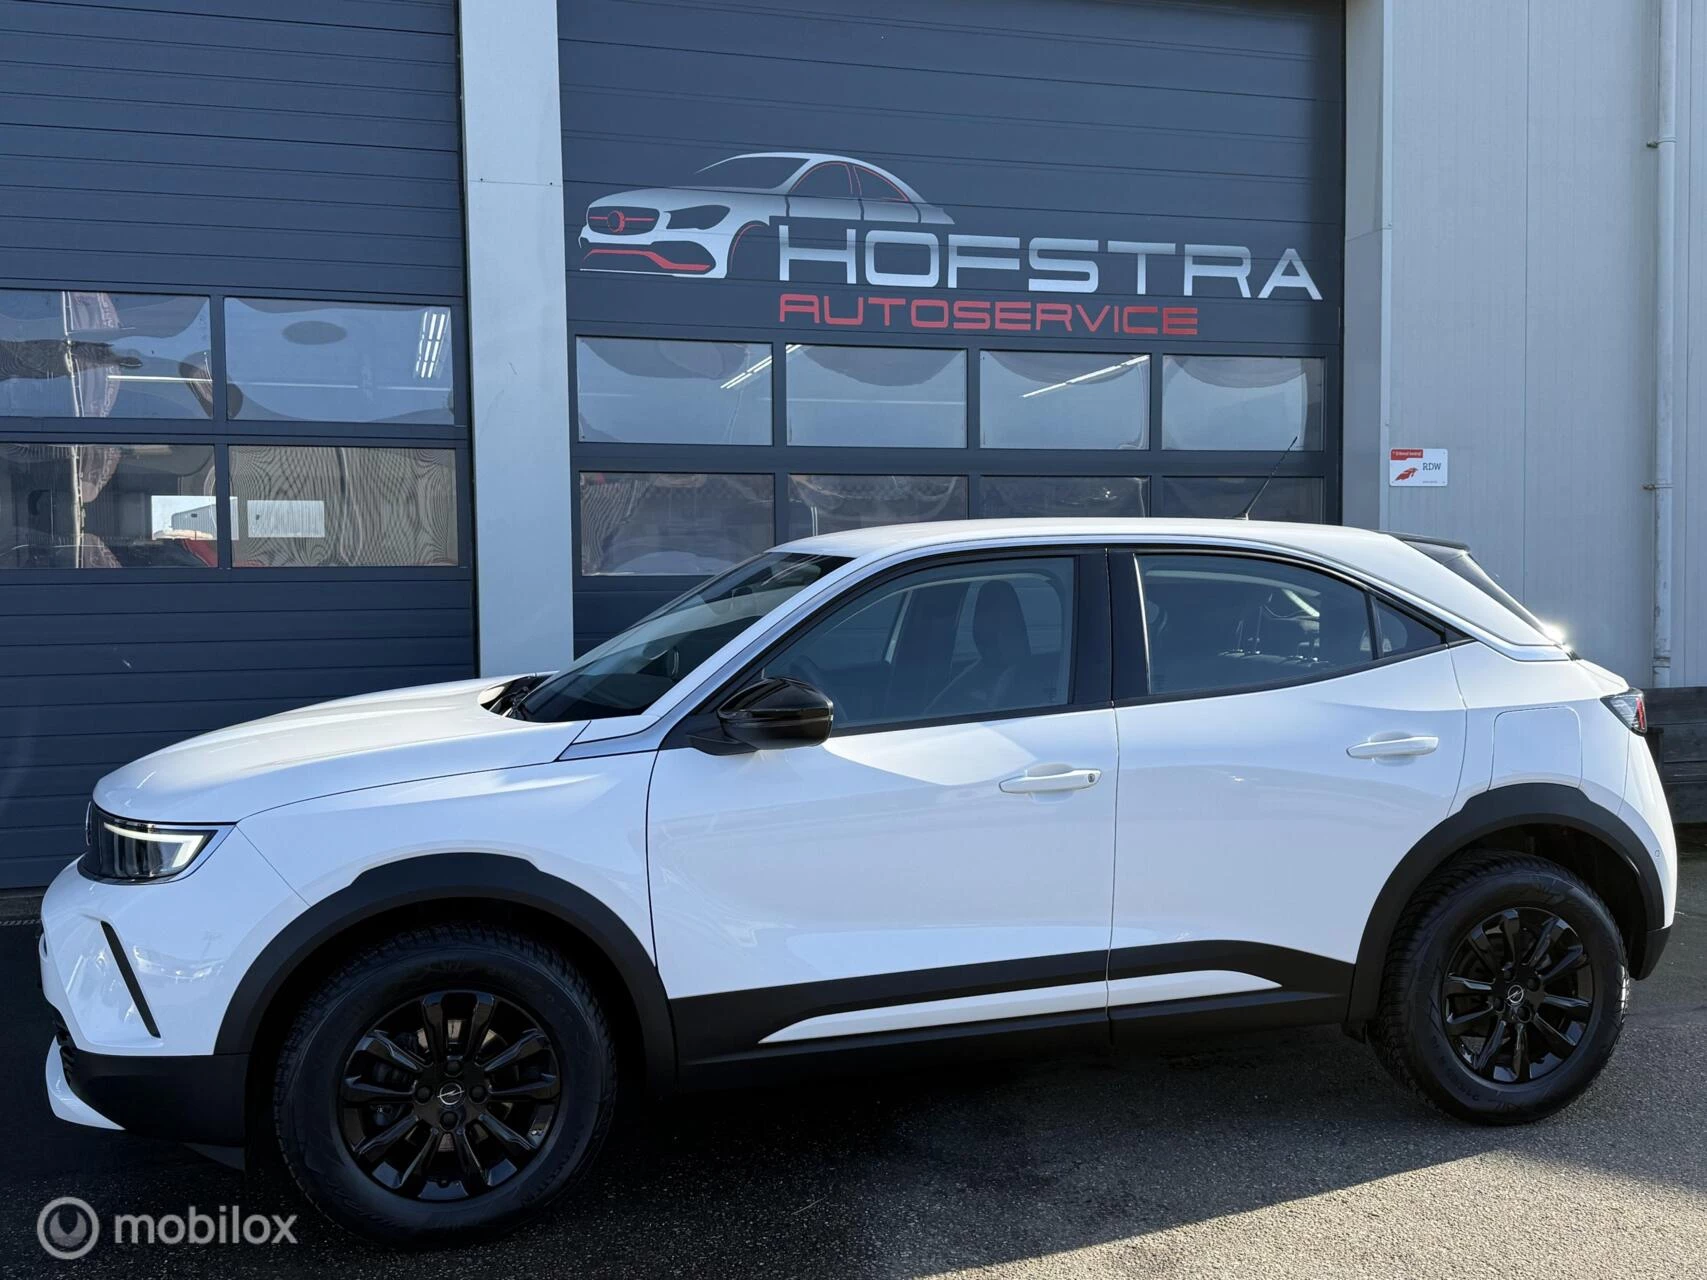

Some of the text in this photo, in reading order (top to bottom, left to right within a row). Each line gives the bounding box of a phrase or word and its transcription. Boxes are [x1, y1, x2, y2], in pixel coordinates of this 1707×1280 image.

[778, 224, 1323, 300] HOFSTRA
[779, 293, 1198, 335] AUTOSERVICE
[1422, 462, 1442, 471] RDW
